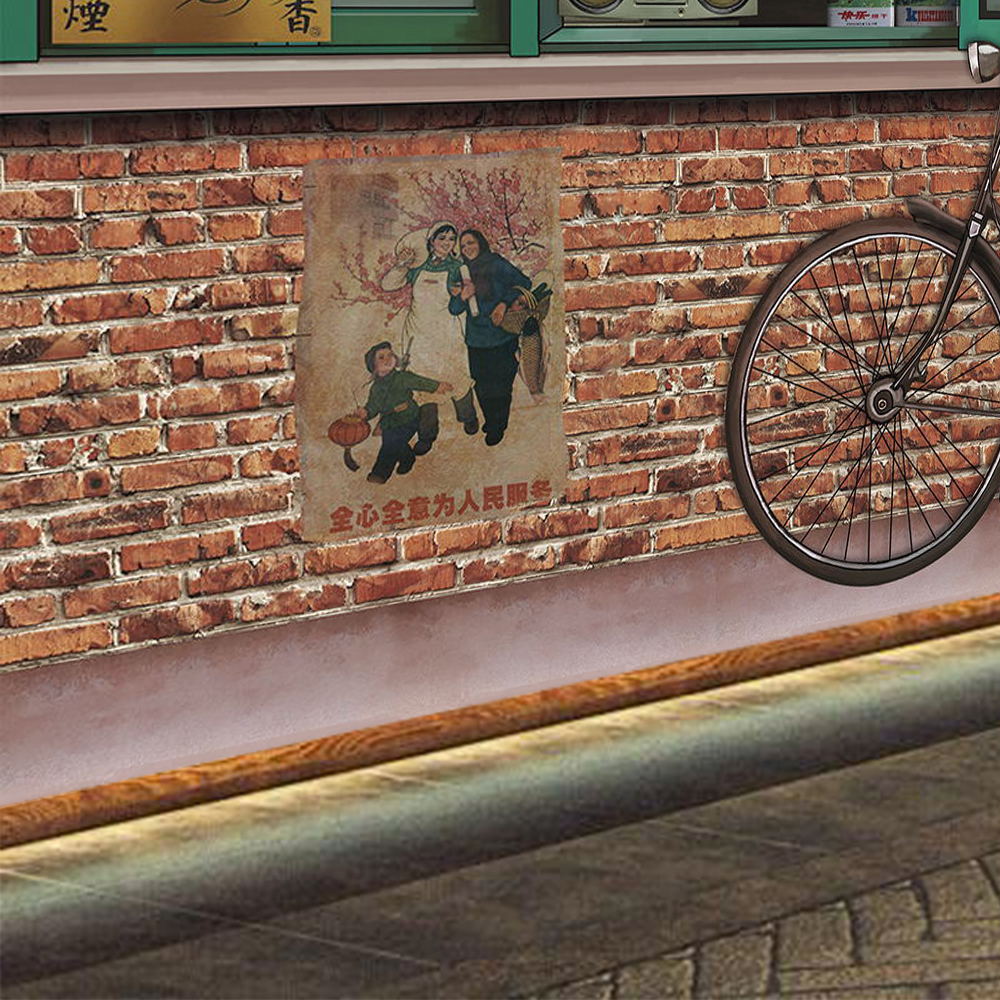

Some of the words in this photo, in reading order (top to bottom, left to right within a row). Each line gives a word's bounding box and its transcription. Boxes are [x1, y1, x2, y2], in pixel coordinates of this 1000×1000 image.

[329, 479, 553, 534] 全心全意为人民服务
